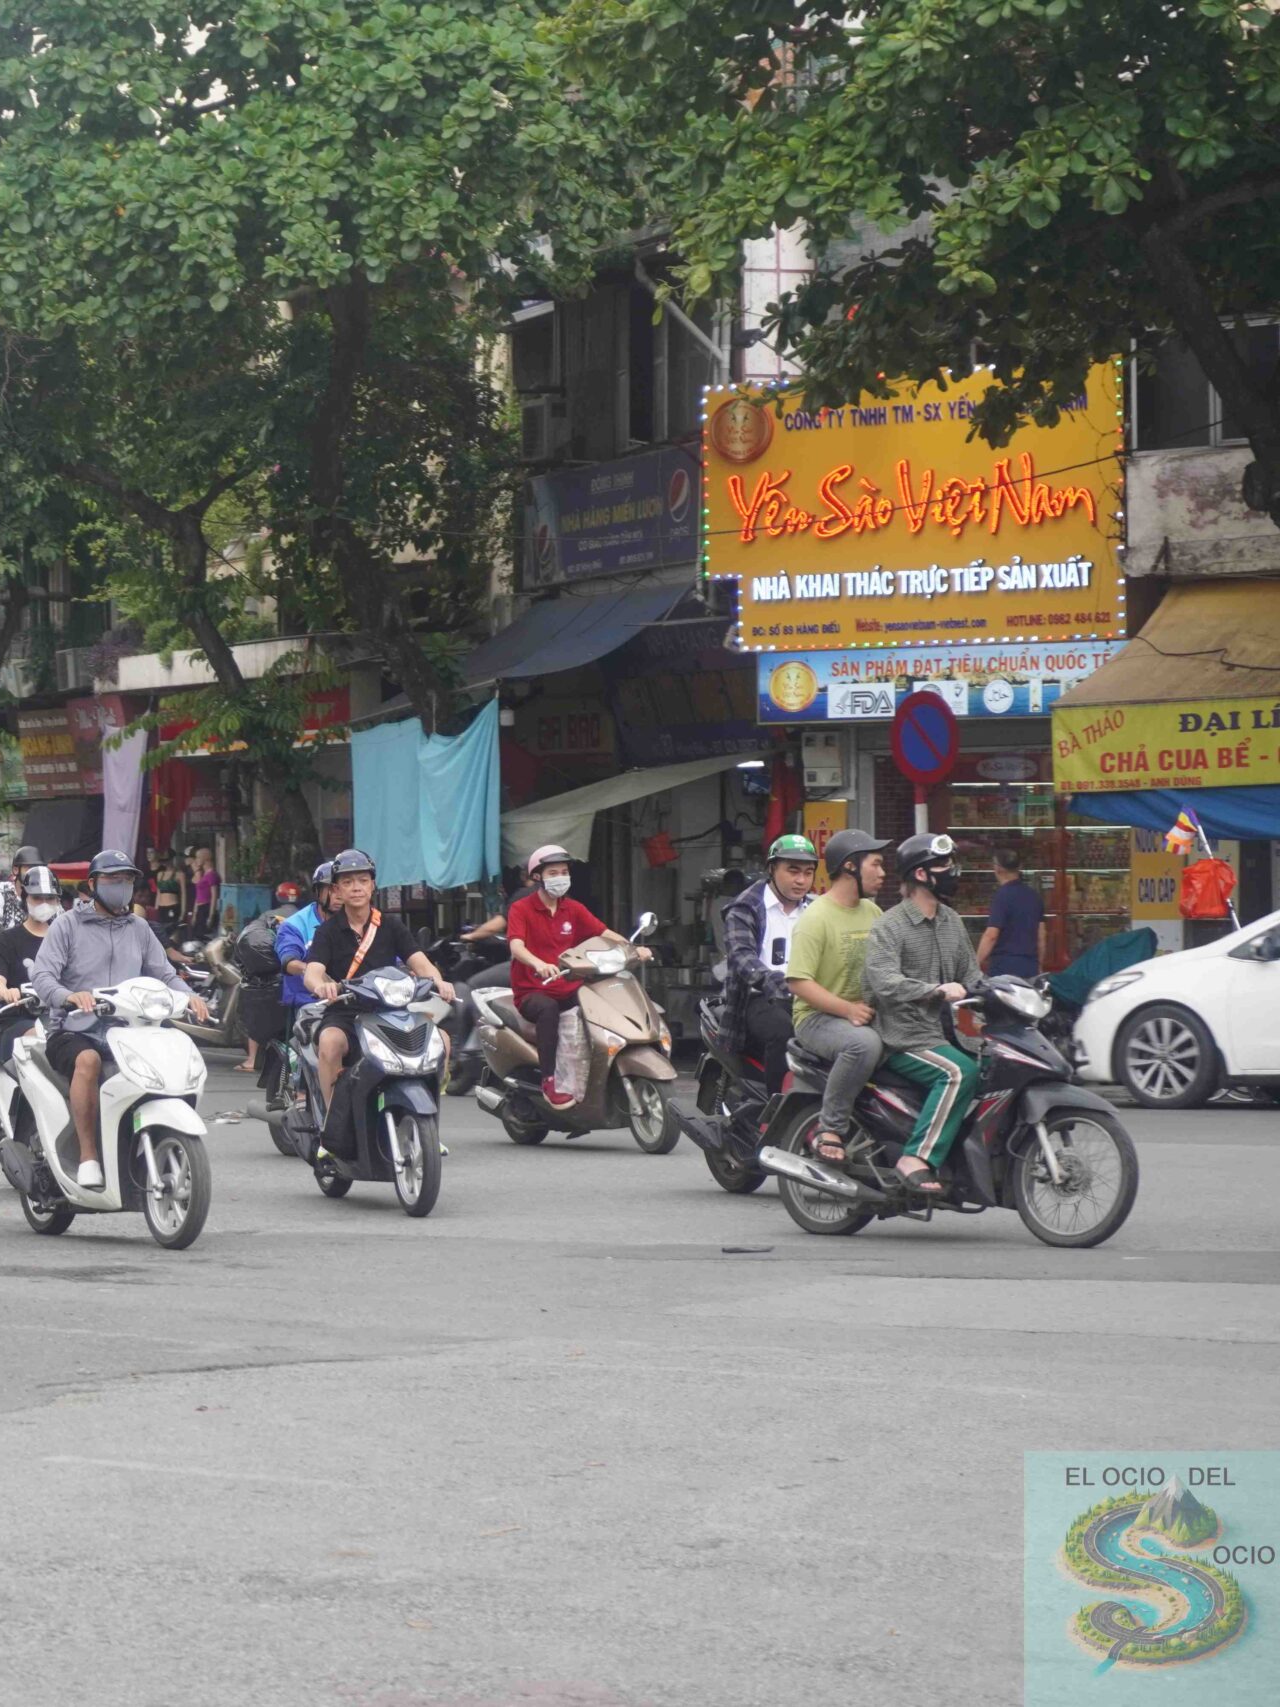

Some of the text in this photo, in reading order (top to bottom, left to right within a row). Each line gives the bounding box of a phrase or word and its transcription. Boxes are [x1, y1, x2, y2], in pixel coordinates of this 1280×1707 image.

[784, 407, 822, 431] CÔNG
[828, 408, 844, 429] TY
[851, 406, 887, 427] TNHH
[727, 451, 1098, 543] Yến Sào Việt Nam
[752, 553, 1094, 602] NHÀ KHAI THÁC TRỰC TIẾP SẢN XUẤT
[831, 655, 860, 677] SẢN
[865, 652, 908, 677] PHẨM
[948, 653, 983, 674] TIÊU
[987, 647, 1040, 674] CHUẨN
[1045, 647, 1087, 671] QUỐC
[851, 690, 893, 714] FDA
[1057, 708, 1126, 759] BÀ THẢO
[1178, 711, 1242, 737] ĐẠI
[1099, 743, 1150, 773] CHẢ
[1158, 739, 1209, 771] CUA
[1217, 736, 1252, 769] BỂ
[1138, 866, 1176, 903] CAO CẤP
